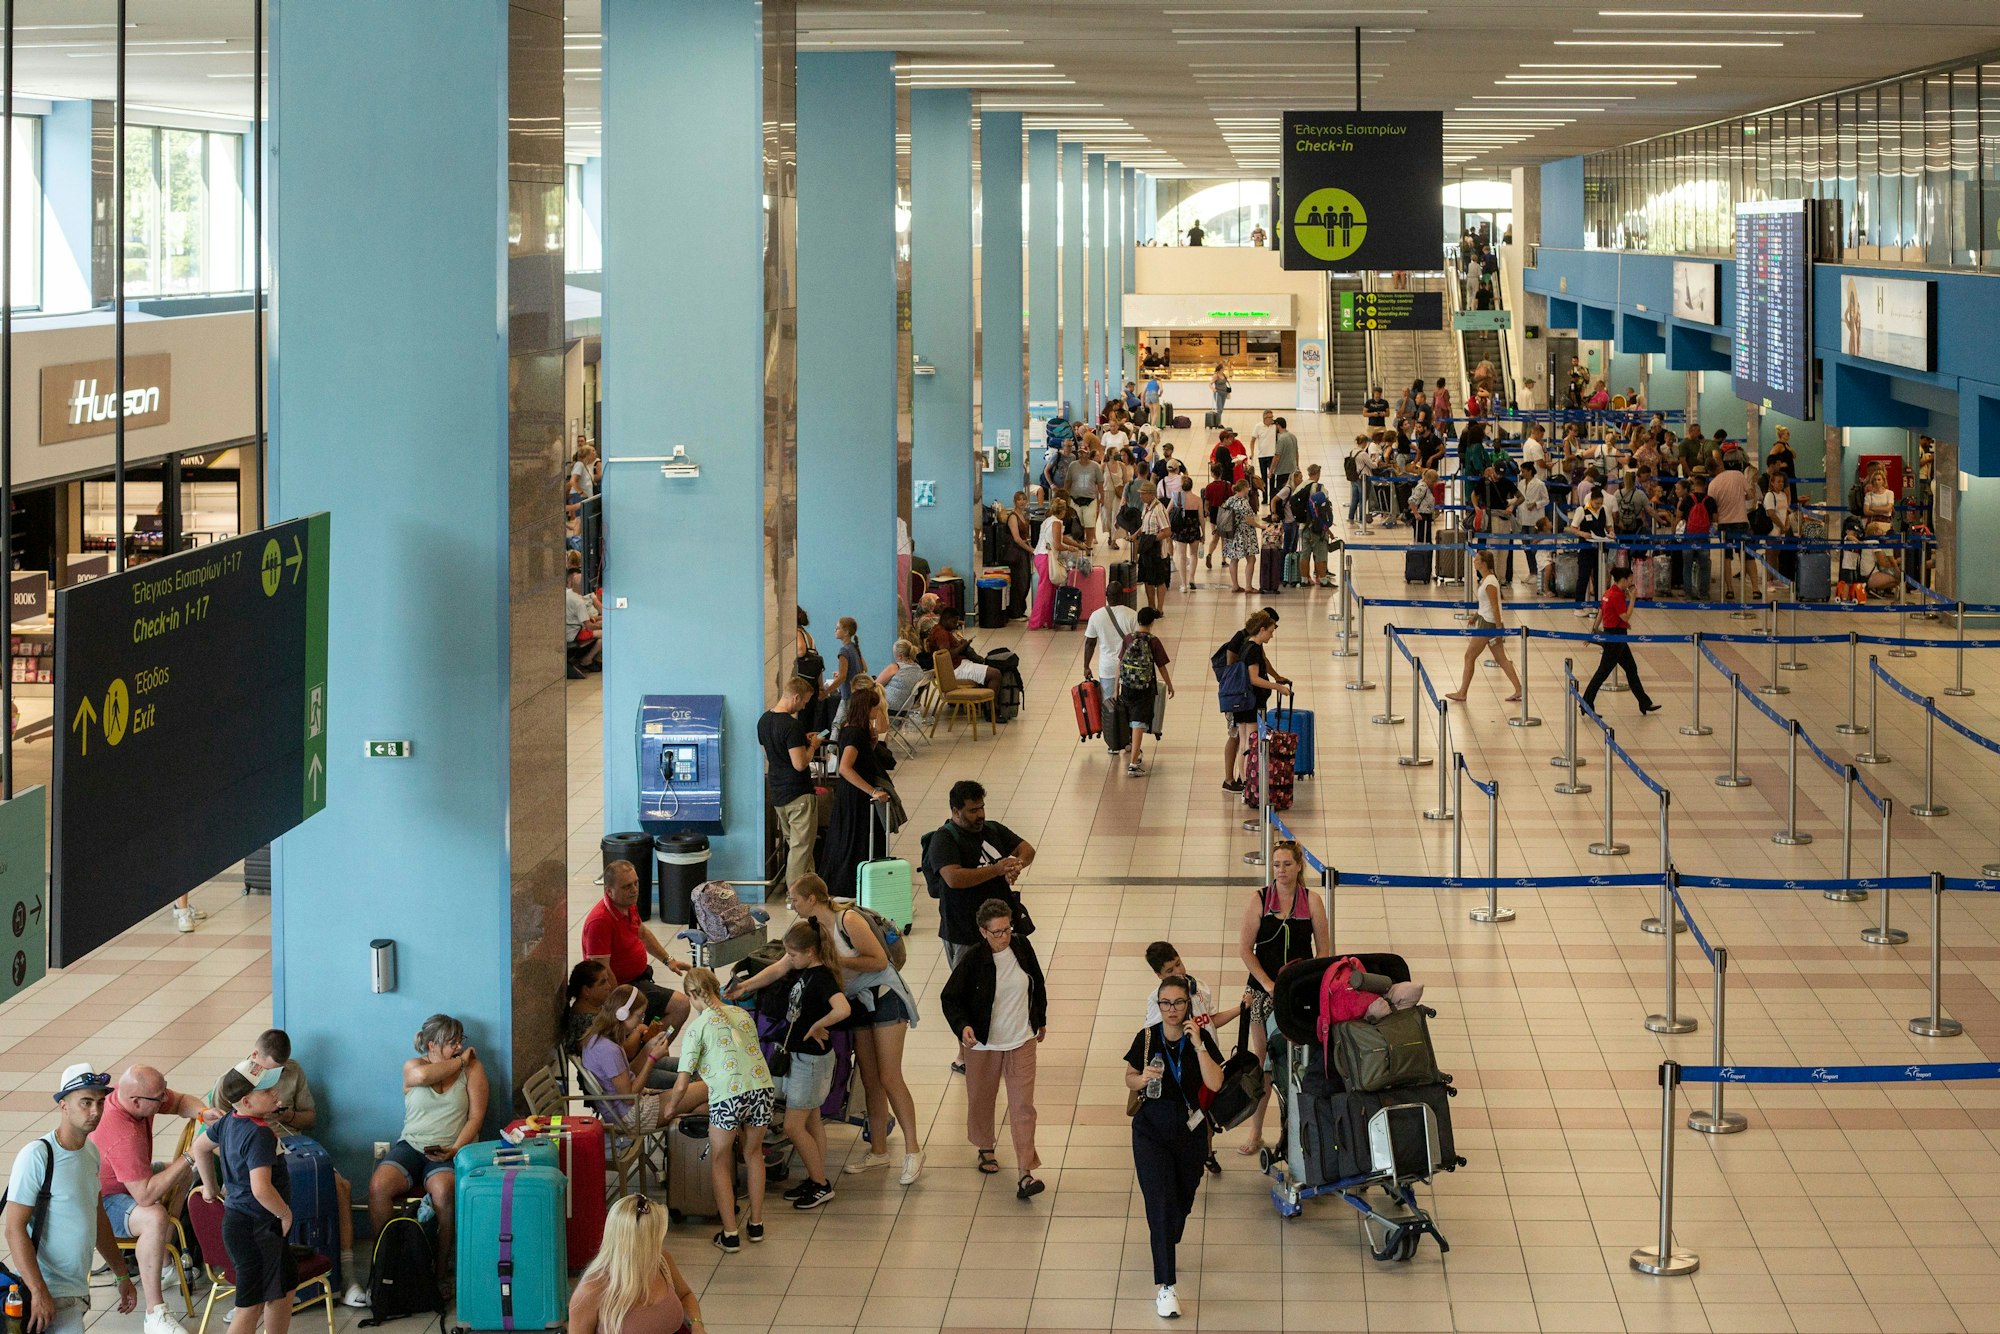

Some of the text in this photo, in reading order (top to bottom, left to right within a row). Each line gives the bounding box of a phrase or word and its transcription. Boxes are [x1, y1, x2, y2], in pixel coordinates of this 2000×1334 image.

[1346, 123, 1407, 138] Εισιτηρίων
[1296, 140, 1353, 152] Check-in
[223, 551, 242, 577] 1-17
[14, 592, 36, 605] BOOKS
[133, 595, 209, 643] Check-in 1-17
[134, 665, 170, 695] Έξοδος
[133, 703, 155, 735] Exit
